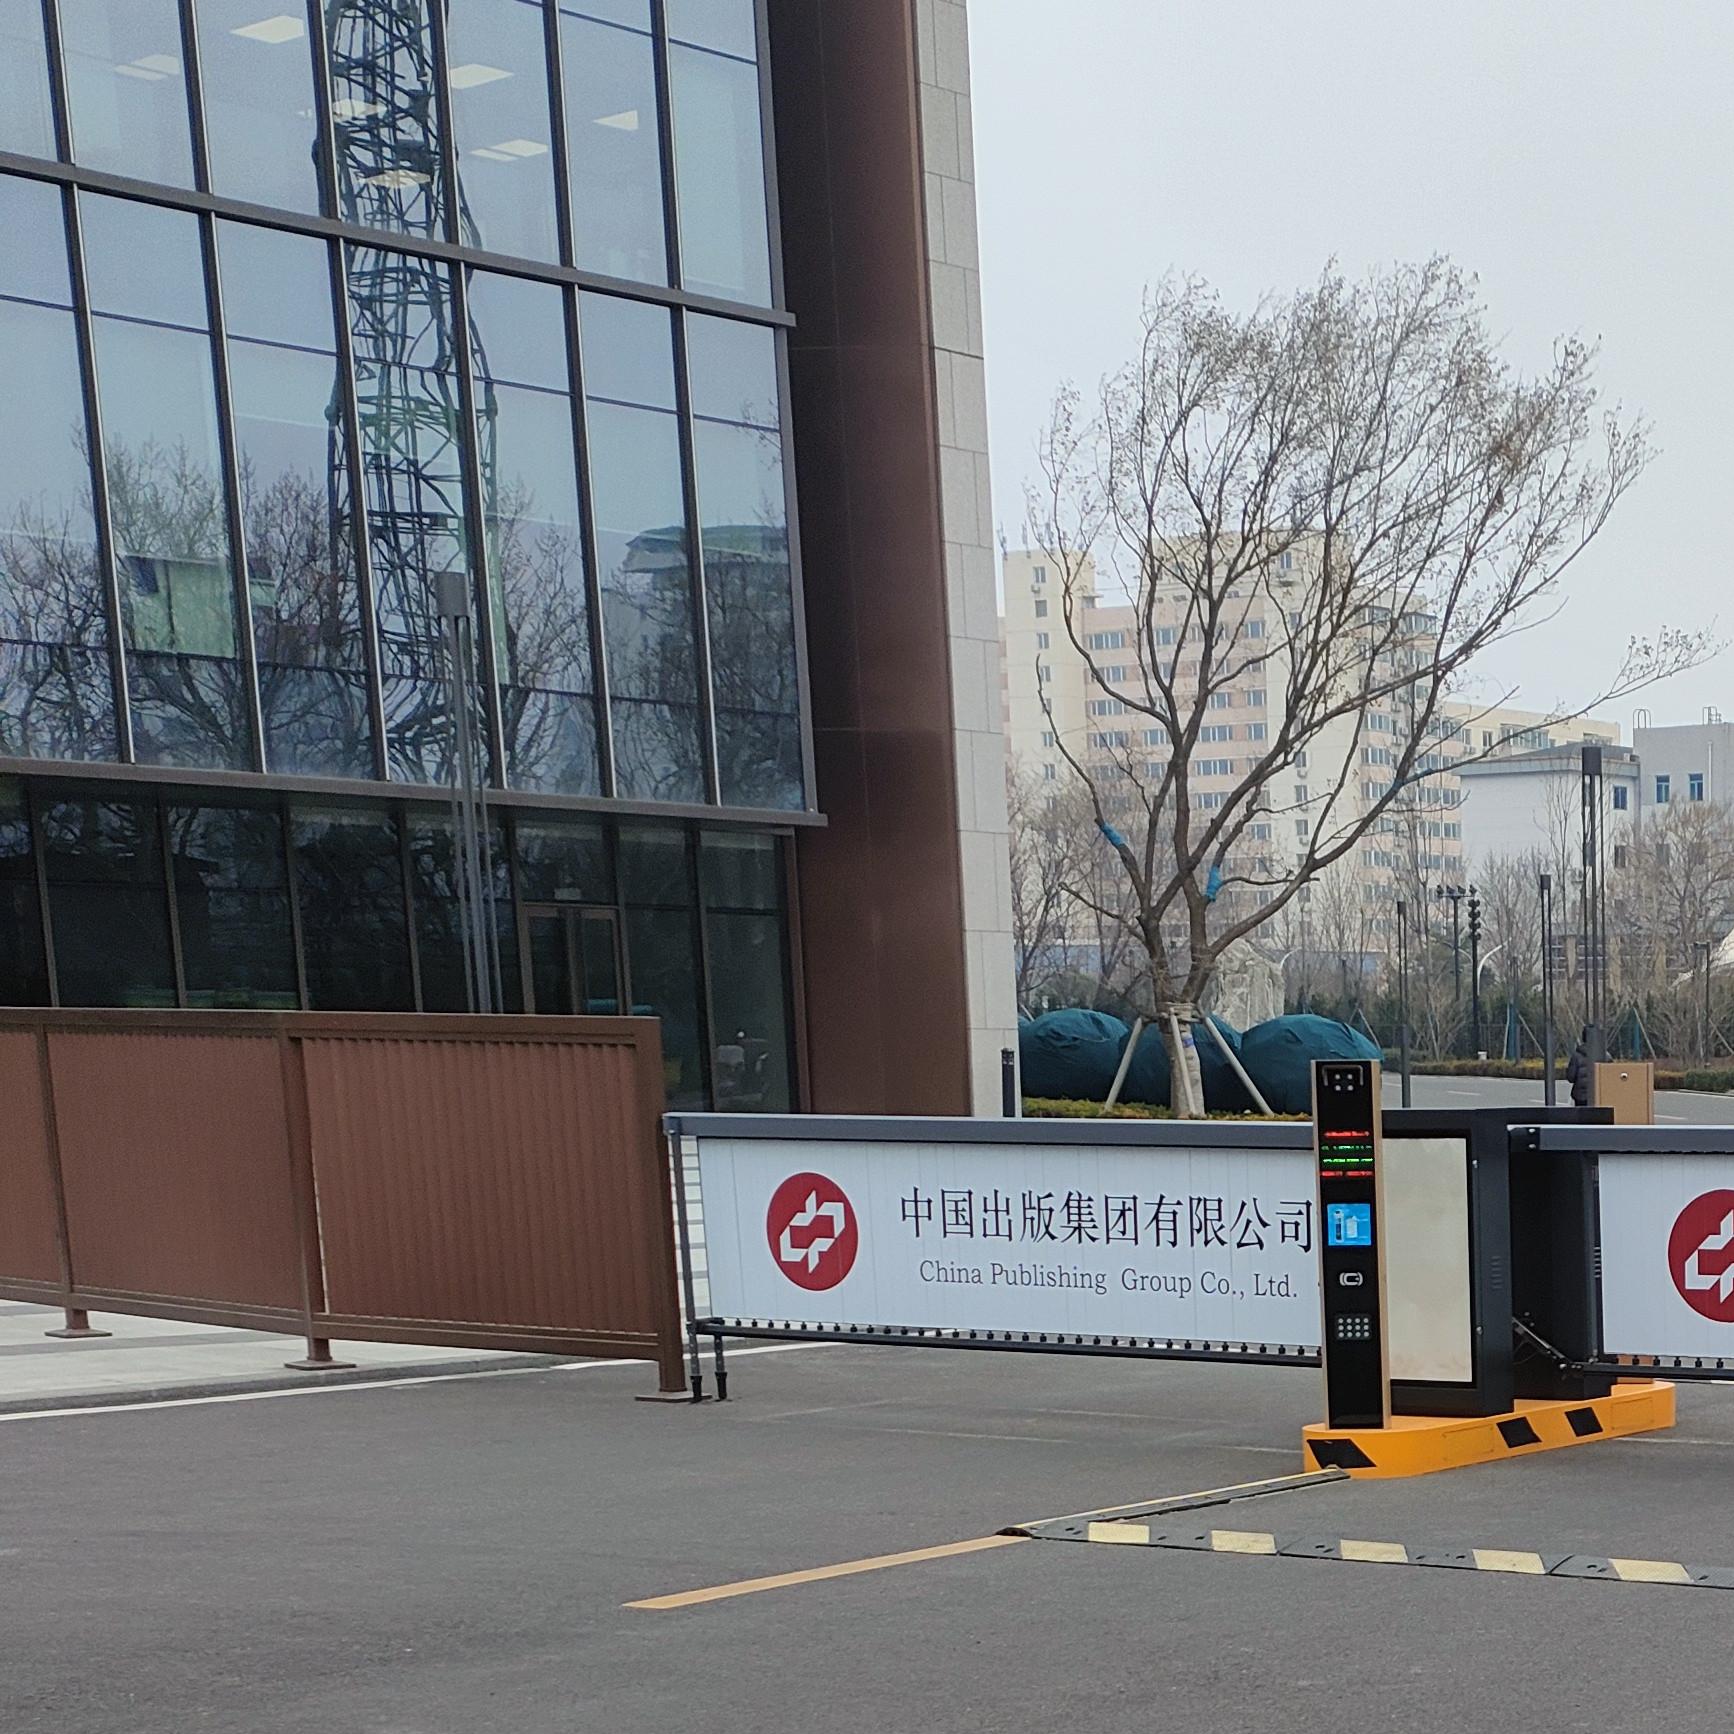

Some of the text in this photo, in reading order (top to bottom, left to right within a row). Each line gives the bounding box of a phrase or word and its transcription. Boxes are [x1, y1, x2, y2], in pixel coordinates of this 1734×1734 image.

[900, 1186, 1313, 1255] 中国出版集团有限公司
[919, 1259, 1299, 1301] China Publishing Group Co., Ltd.
